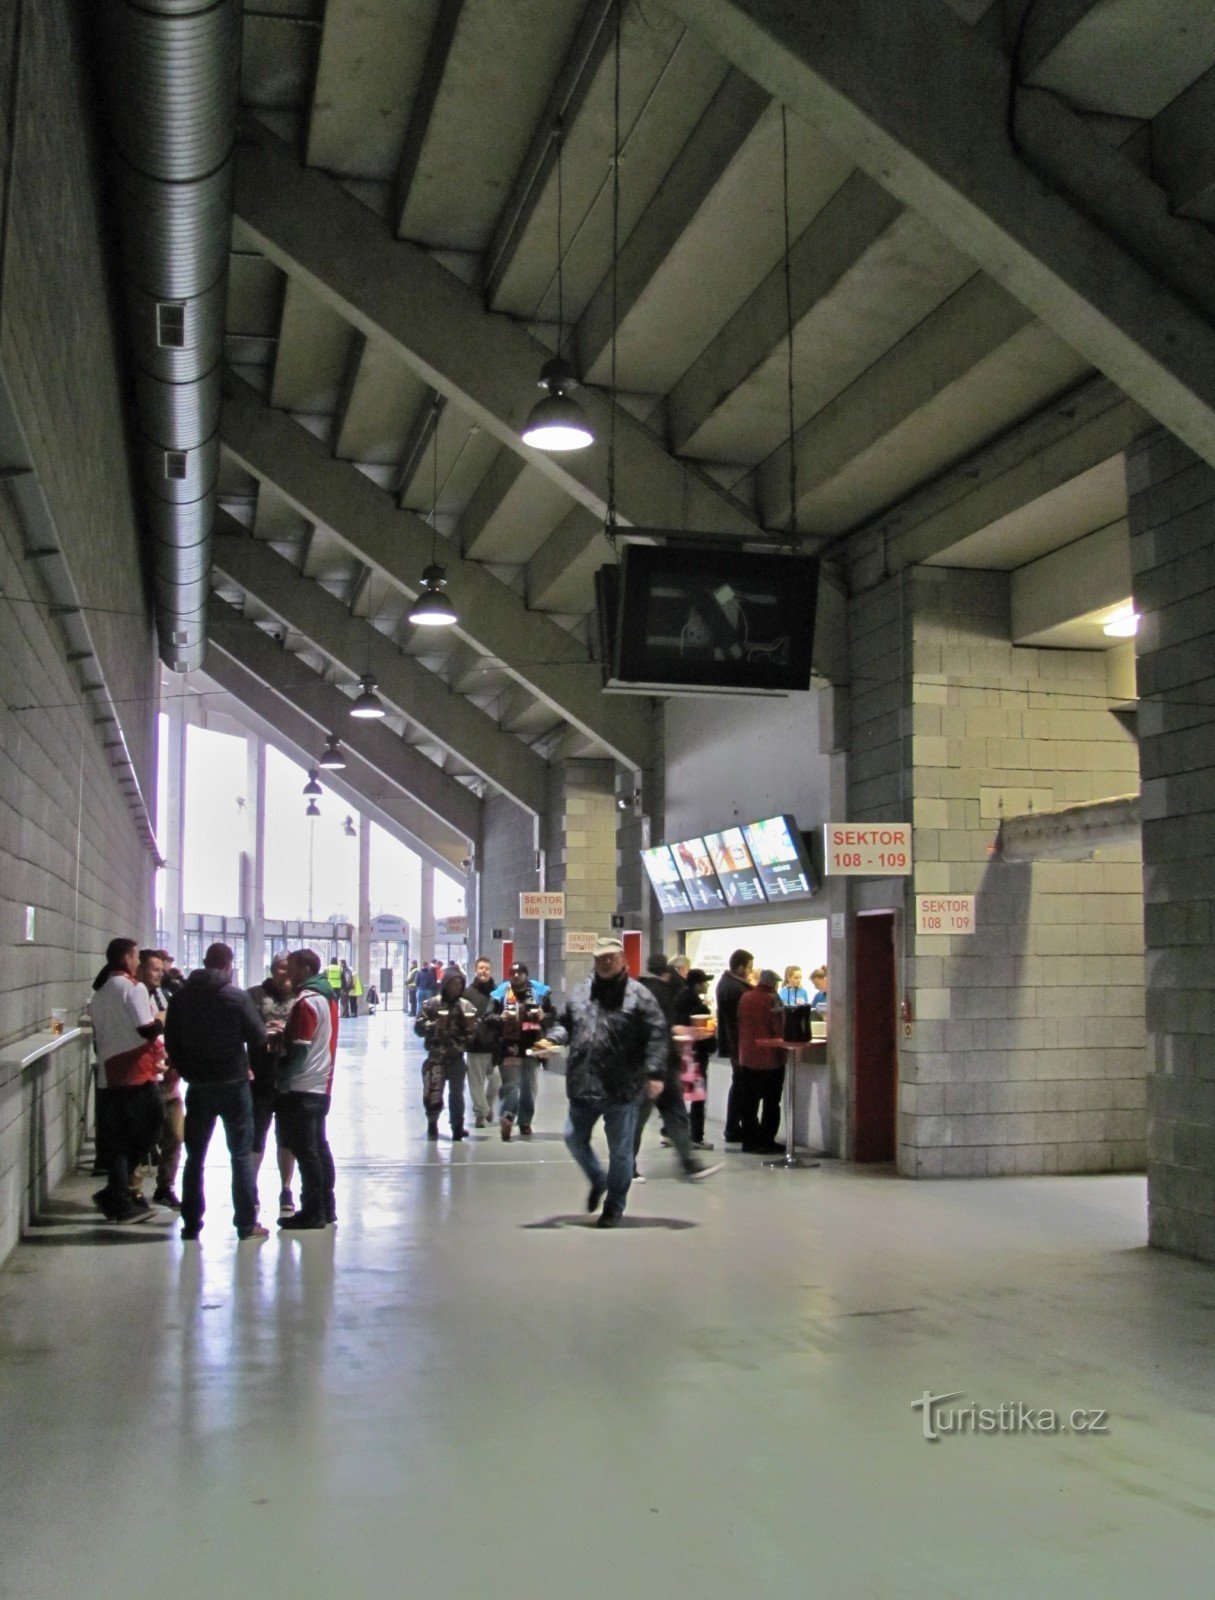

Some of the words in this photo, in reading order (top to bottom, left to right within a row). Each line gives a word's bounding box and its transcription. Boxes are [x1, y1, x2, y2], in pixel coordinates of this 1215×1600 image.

[833, 830, 905, 845] SEKTOR
[833, 853, 862, 867] 108
[878, 853, 906, 867] 109
[524, 895, 562, 904] SEKTOR
[524, 907, 540, 915] 109
[548, 907, 563, 915] 110
[921, 900, 969, 912] SEKTOR
[921, 917, 941, 929] 108
[950, 917, 970, 929] 109
